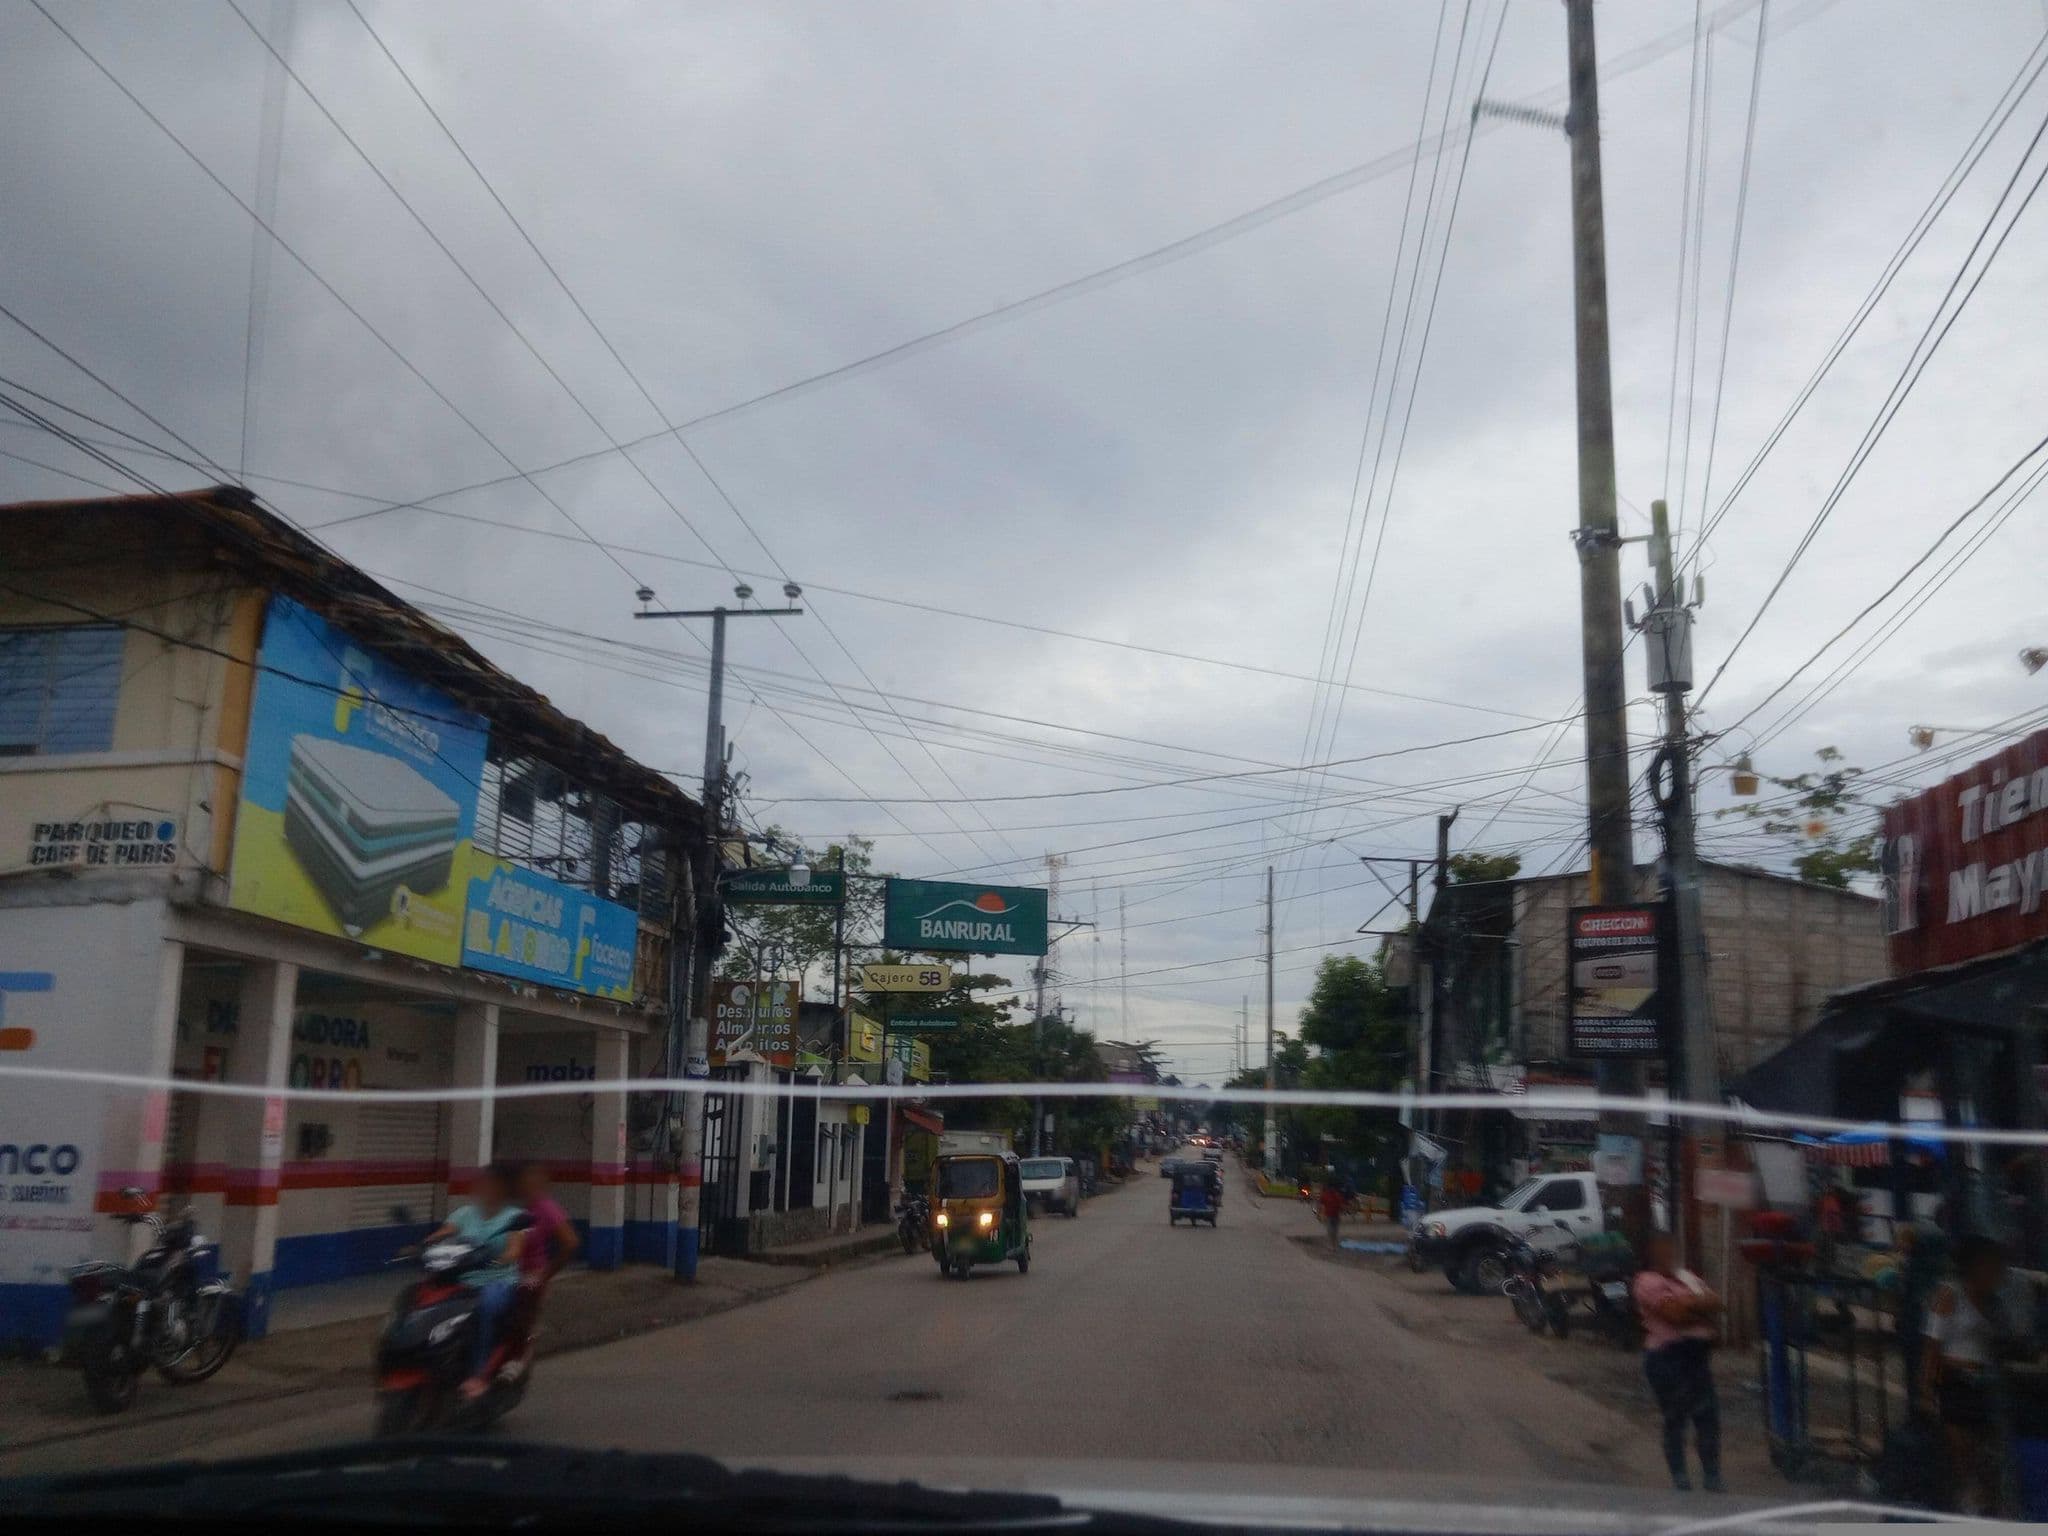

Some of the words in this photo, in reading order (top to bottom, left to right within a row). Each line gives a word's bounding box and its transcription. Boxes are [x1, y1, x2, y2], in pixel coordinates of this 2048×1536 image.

[32, 821, 154, 843] PARQUEO
[86, 845, 109, 865] DE
[115, 844, 177, 865] PARIS
[730, 879, 766, 891] Salida
[769, 881, 833, 893] Autobanco
[920, 919, 1016, 943] BANRURAL
[870, 971, 914, 985] Cajero
[918, 971, 942, 987] 5B
